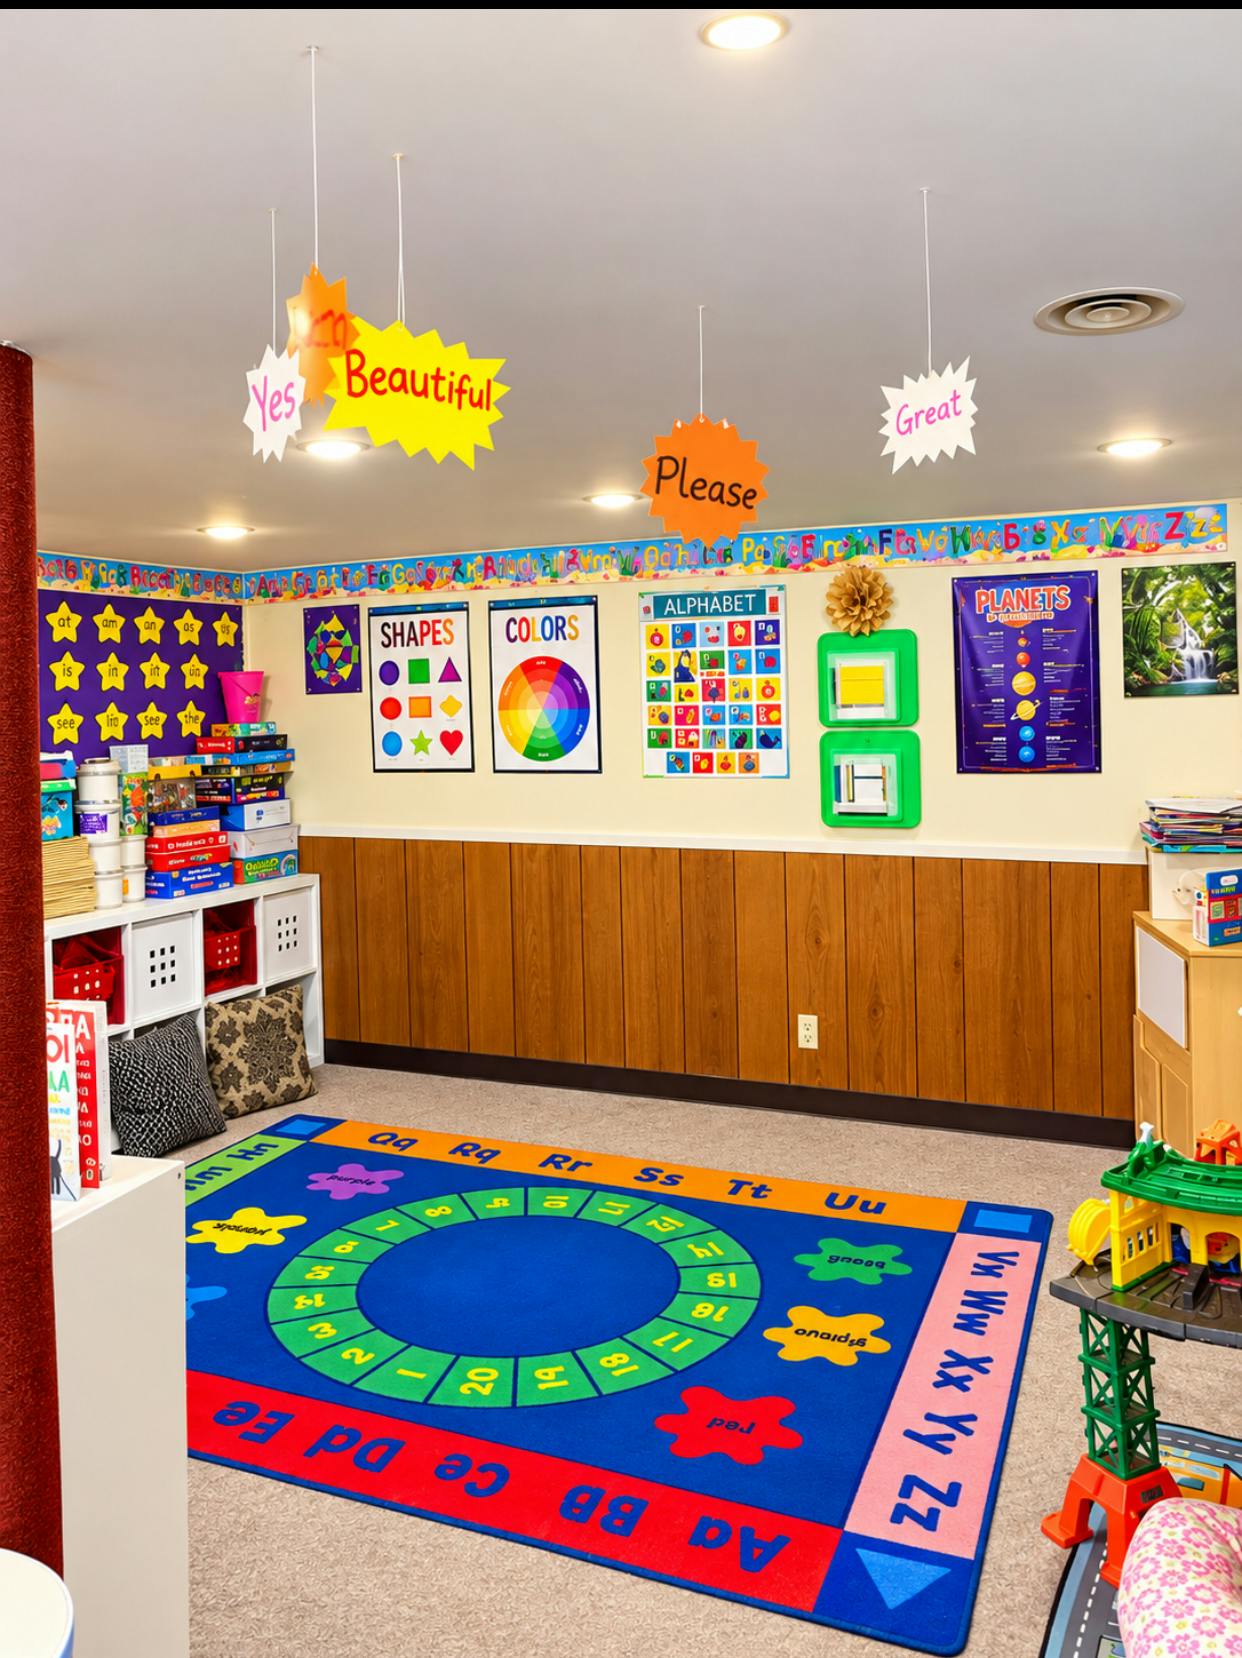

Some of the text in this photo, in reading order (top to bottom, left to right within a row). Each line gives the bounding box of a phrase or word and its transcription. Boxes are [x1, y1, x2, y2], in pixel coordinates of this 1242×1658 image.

[345, 349, 491, 411] Beautiful
[252, 376, 295, 432] Yes
[896, 389, 961, 436] Great
[655, 456, 757, 510] Please
[664, 594, 756, 616] ALPHABET
[975, 585, 1071, 614] PLANETS
[58, 615, 71, 628] at
[102, 617, 118, 628] am
[144, 620, 156, 631] an
[381, 618, 454, 648] SHAPES
[506, 615, 579, 643] COLORS
[62, 664, 73, 677] is
[108, 663, 118, 677] in
[56, 717, 75, 729] see
[143, 714, 160, 726] see
[183, 712, 200, 725] the
[368, 1133, 418, 1151] Qq
[538, 1153, 592, 1172] Rr
[634, 1167, 684, 1186] Ss
[728, 1179, 773, 1199] Tt
[825, 1192, 887, 1215] Uu
[425, 1205, 452, 1217] 8
[953, 1290, 1008, 1336] Ww
[308, 1322, 337, 1339] 3
[341, 1348, 374, 1365] 2
[599, 1354, 639, 1377] 18
[396, 1368, 426, 1379] 1
[459, 1367, 499, 1396] 20
[534, 1366, 569, 1390] 19
[932, 1350, 994, 1393] Xx
[213, 1402, 294, 1445] Ee
[706, 1417, 756, 1435] red
[903, 1413, 978, 1455] Yy
[304, 1424, 406, 1474] Dd
[559, 1484, 650, 1538] BB
[890, 1475, 962, 1532] Zz
[687, 1515, 790, 1574] Aa
